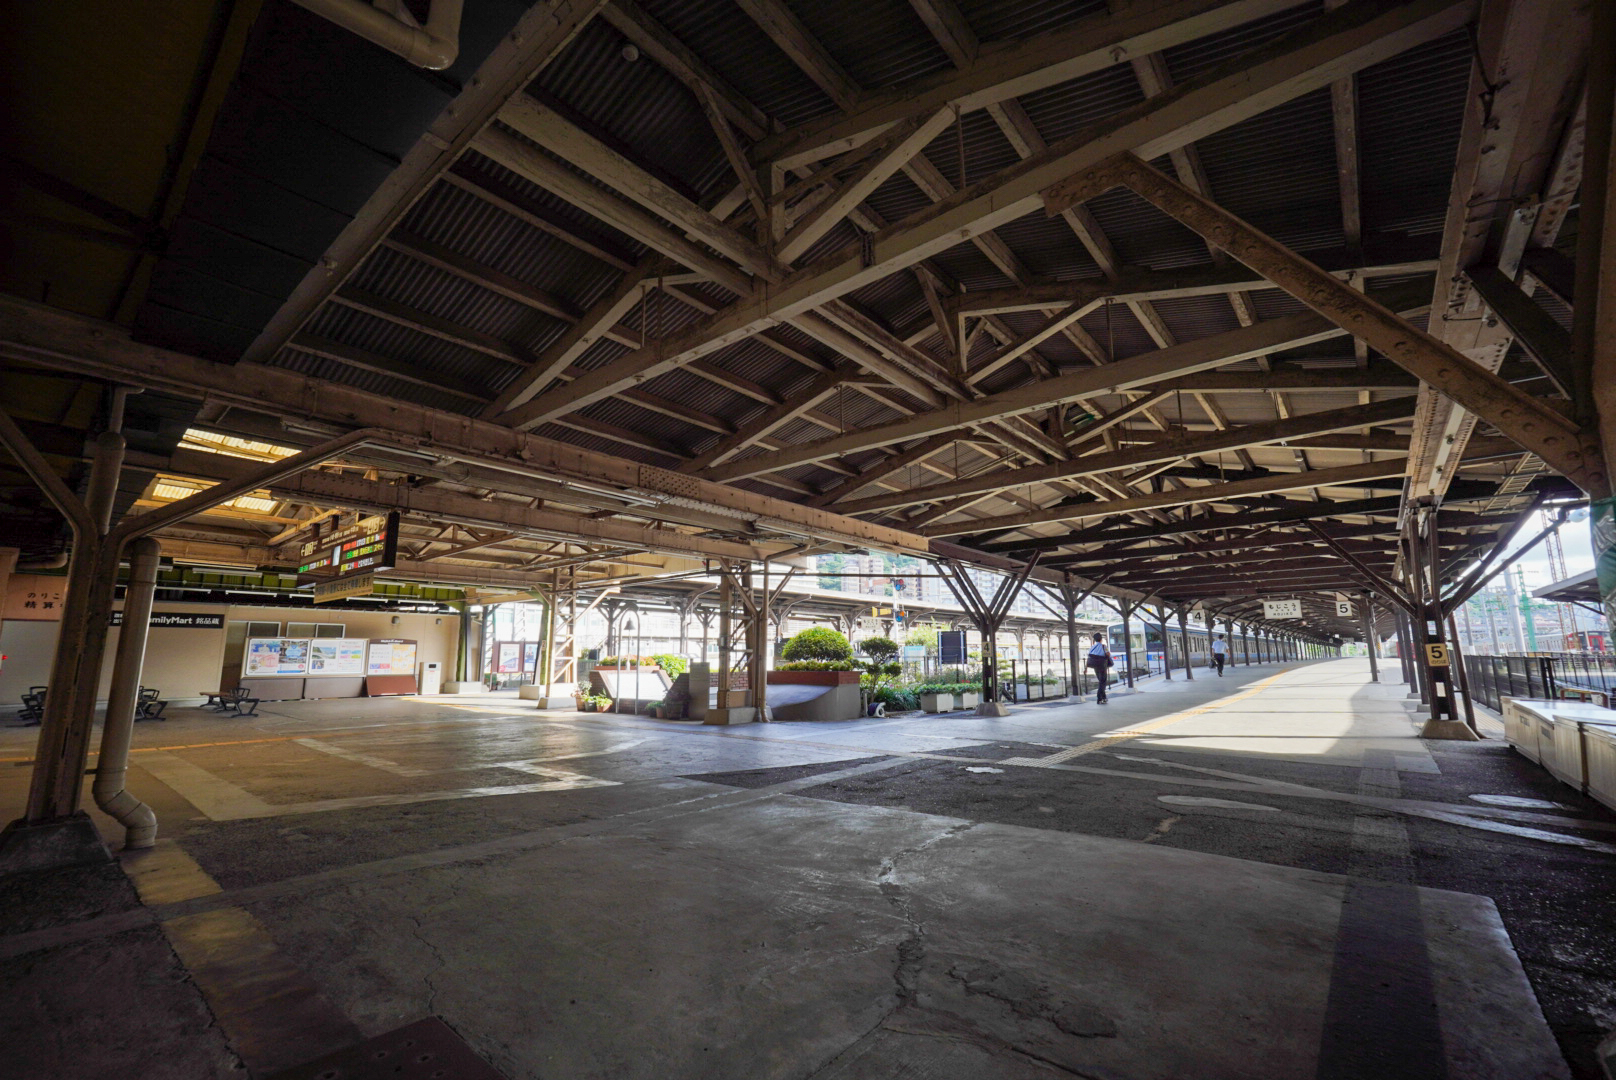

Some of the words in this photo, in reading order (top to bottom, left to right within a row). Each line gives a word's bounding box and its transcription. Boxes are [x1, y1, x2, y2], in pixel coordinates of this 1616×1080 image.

[27, 592, 60, 600] のりこ
[24, 600, 63, 609] 精算
[1339, 603, 1349, 614] 5
[1194, 611, 1202, 620] 4
[149, 616, 193, 625] milyMart
[841, 621, 846, 629] 2
[983, 642, 990, 652] 4
[1431, 645, 1443, 659] 5
